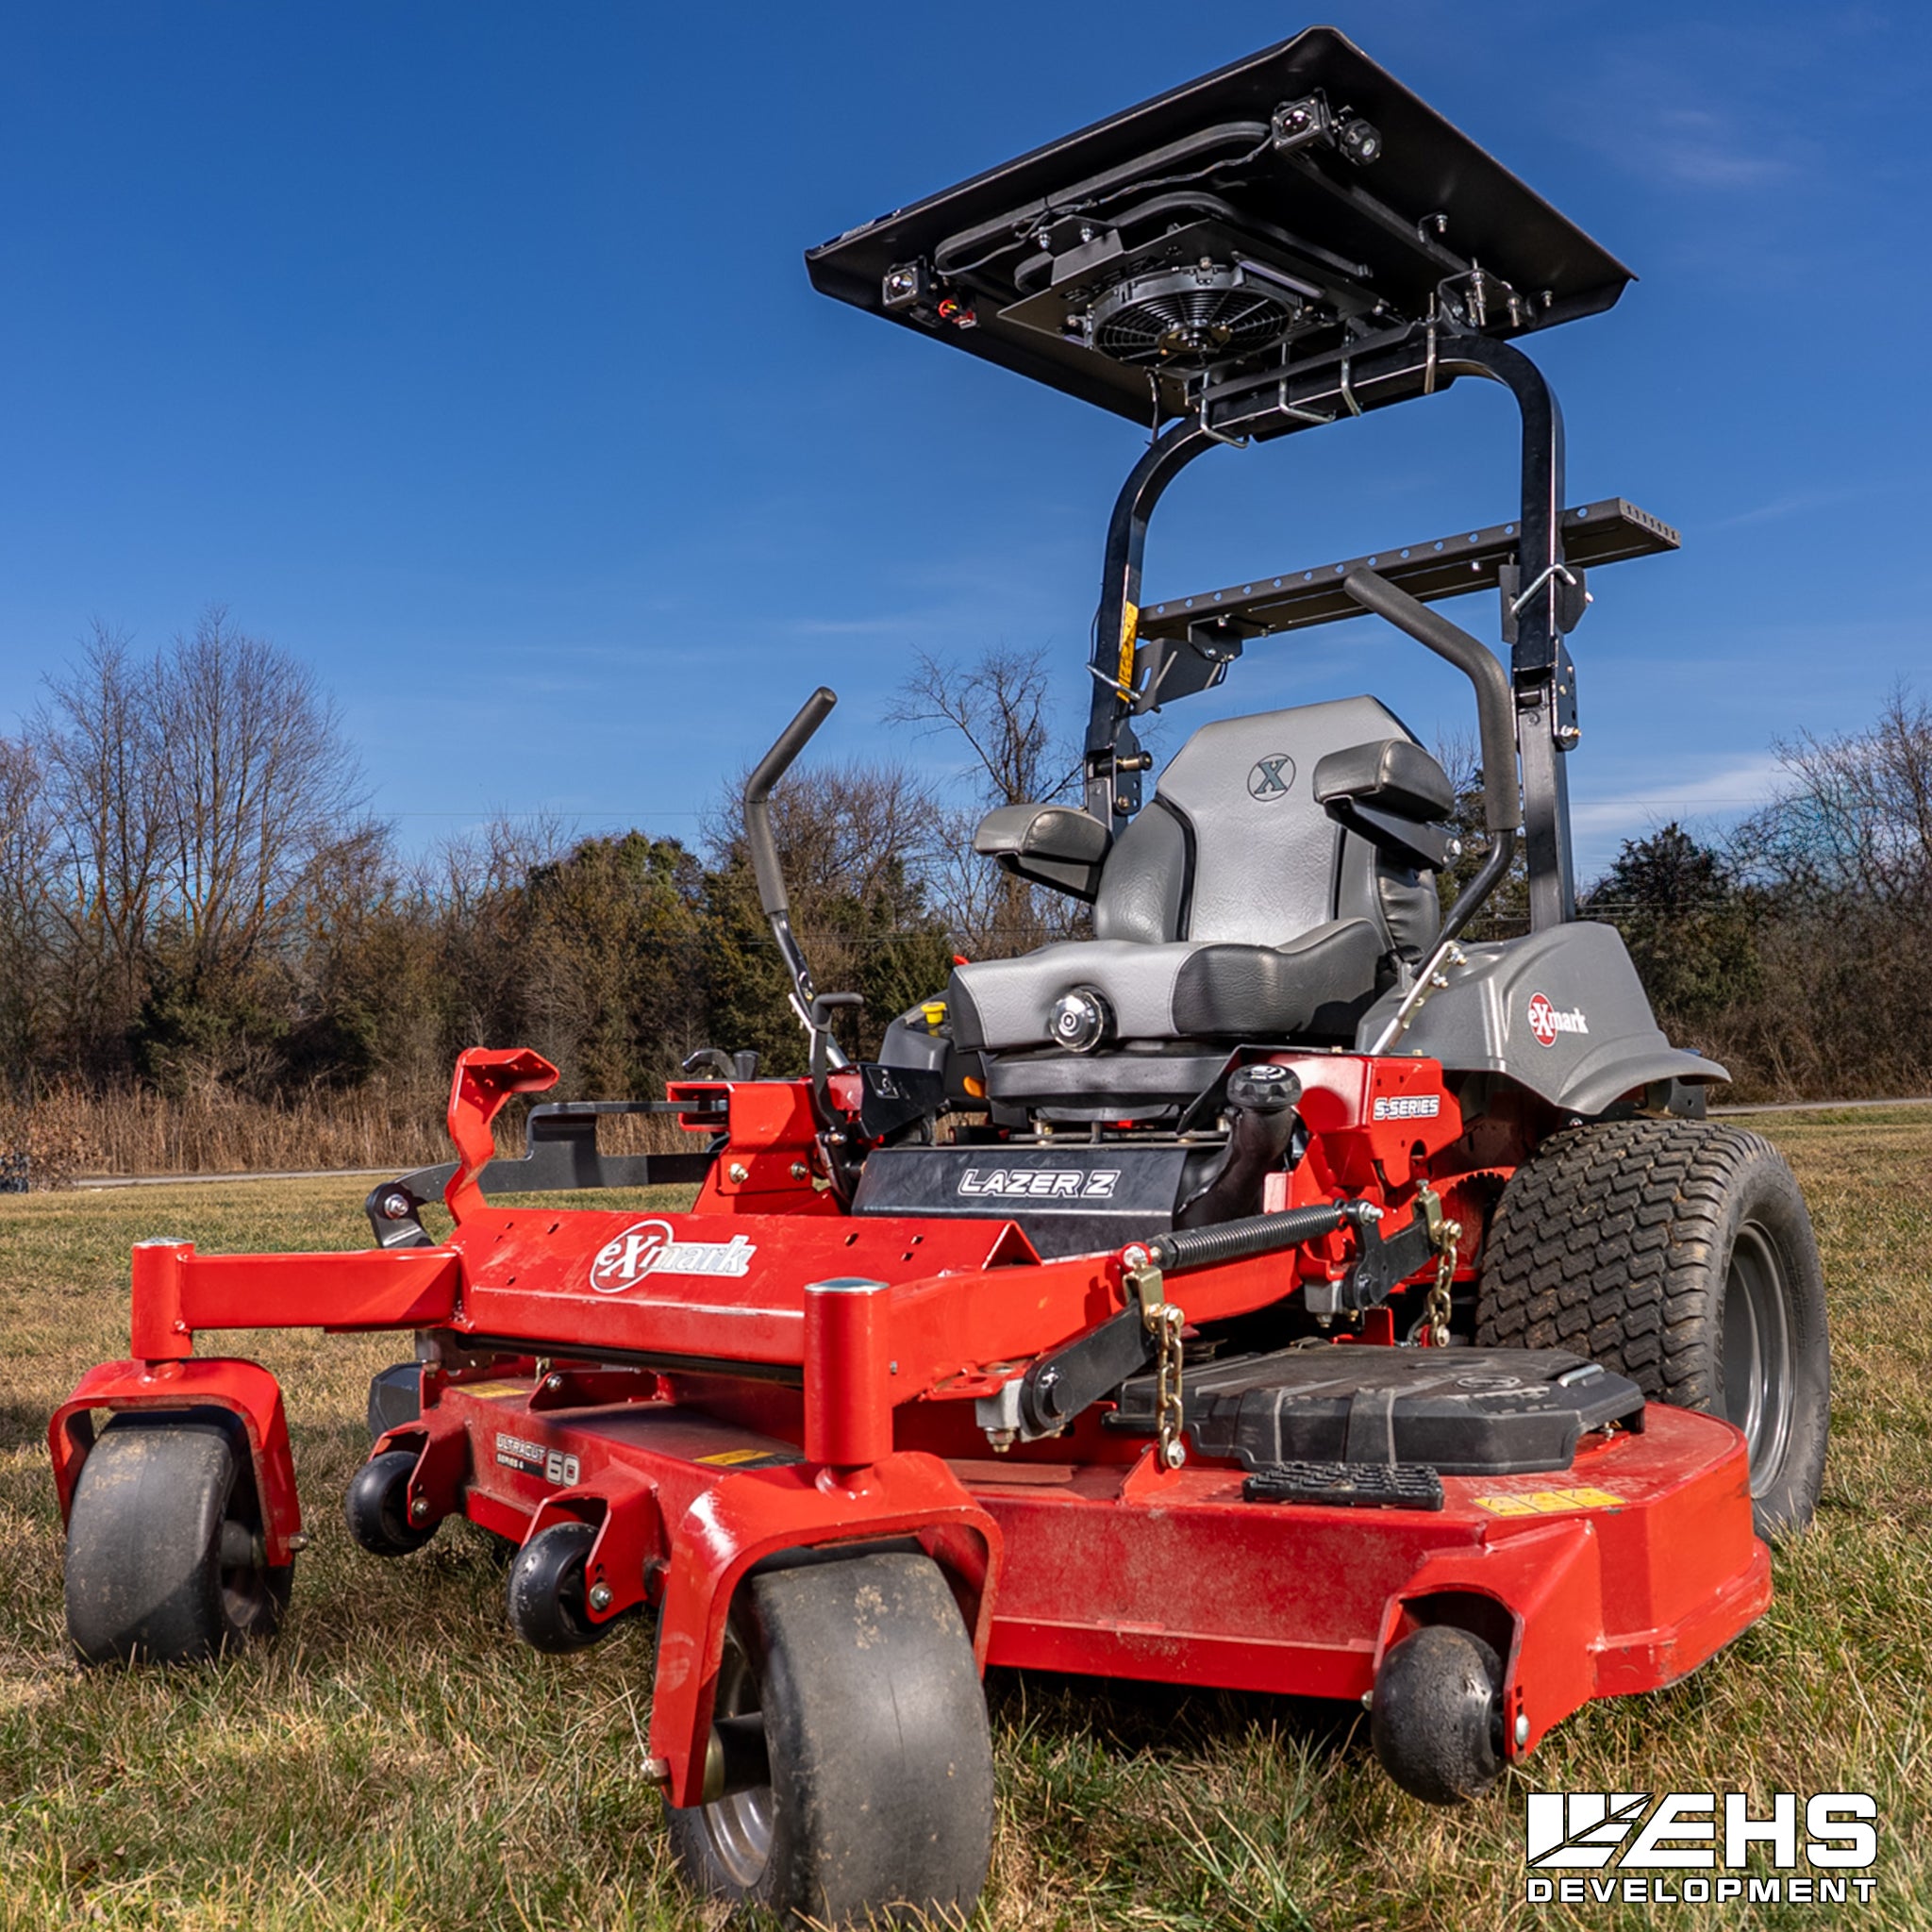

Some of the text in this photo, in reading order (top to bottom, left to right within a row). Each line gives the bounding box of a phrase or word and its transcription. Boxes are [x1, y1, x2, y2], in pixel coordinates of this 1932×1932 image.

[1253, 758, 1289, 794] X
[1374, 1095, 1440, 1120] S-SERIES
[958, 1169, 1121, 1198] LAZER Z
[496, 1433, 579, 1488] ULTRACUT 60
